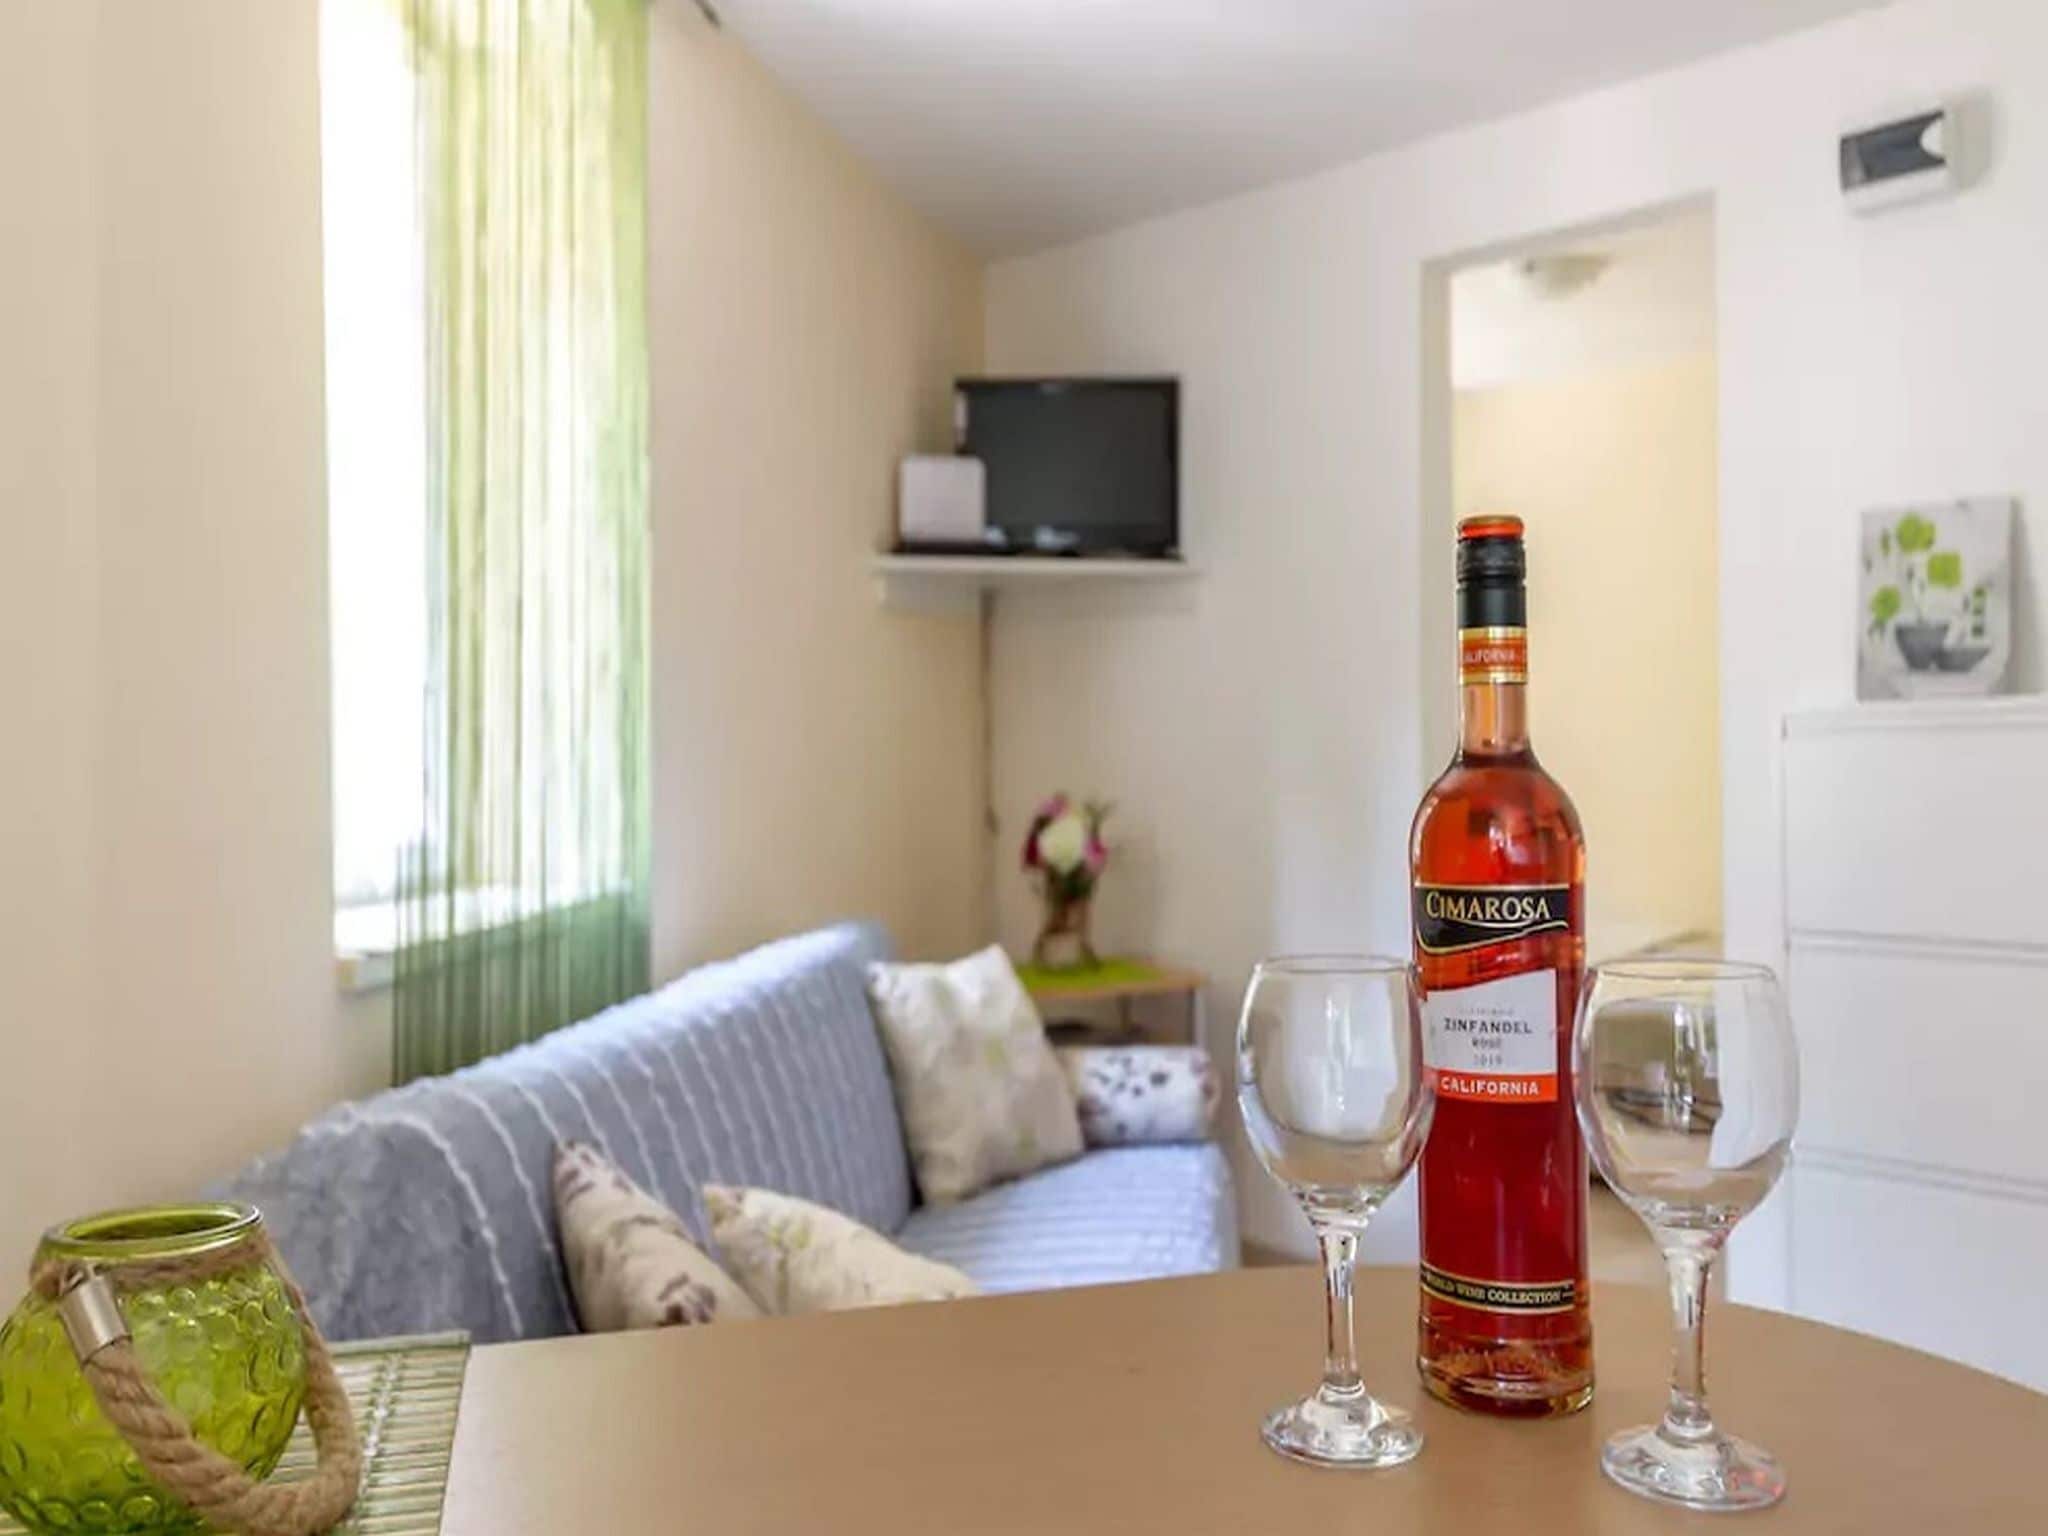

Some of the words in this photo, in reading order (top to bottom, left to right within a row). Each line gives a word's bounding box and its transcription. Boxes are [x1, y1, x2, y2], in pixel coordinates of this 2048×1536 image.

[1426, 891, 1551, 920] CIMAROSA
[1444, 1017, 1533, 1034] ZINFANDEL
[1440, 1076, 1540, 1096] CALIFORNIA
[1487, 1288, 1561, 1304] COLLECTION
